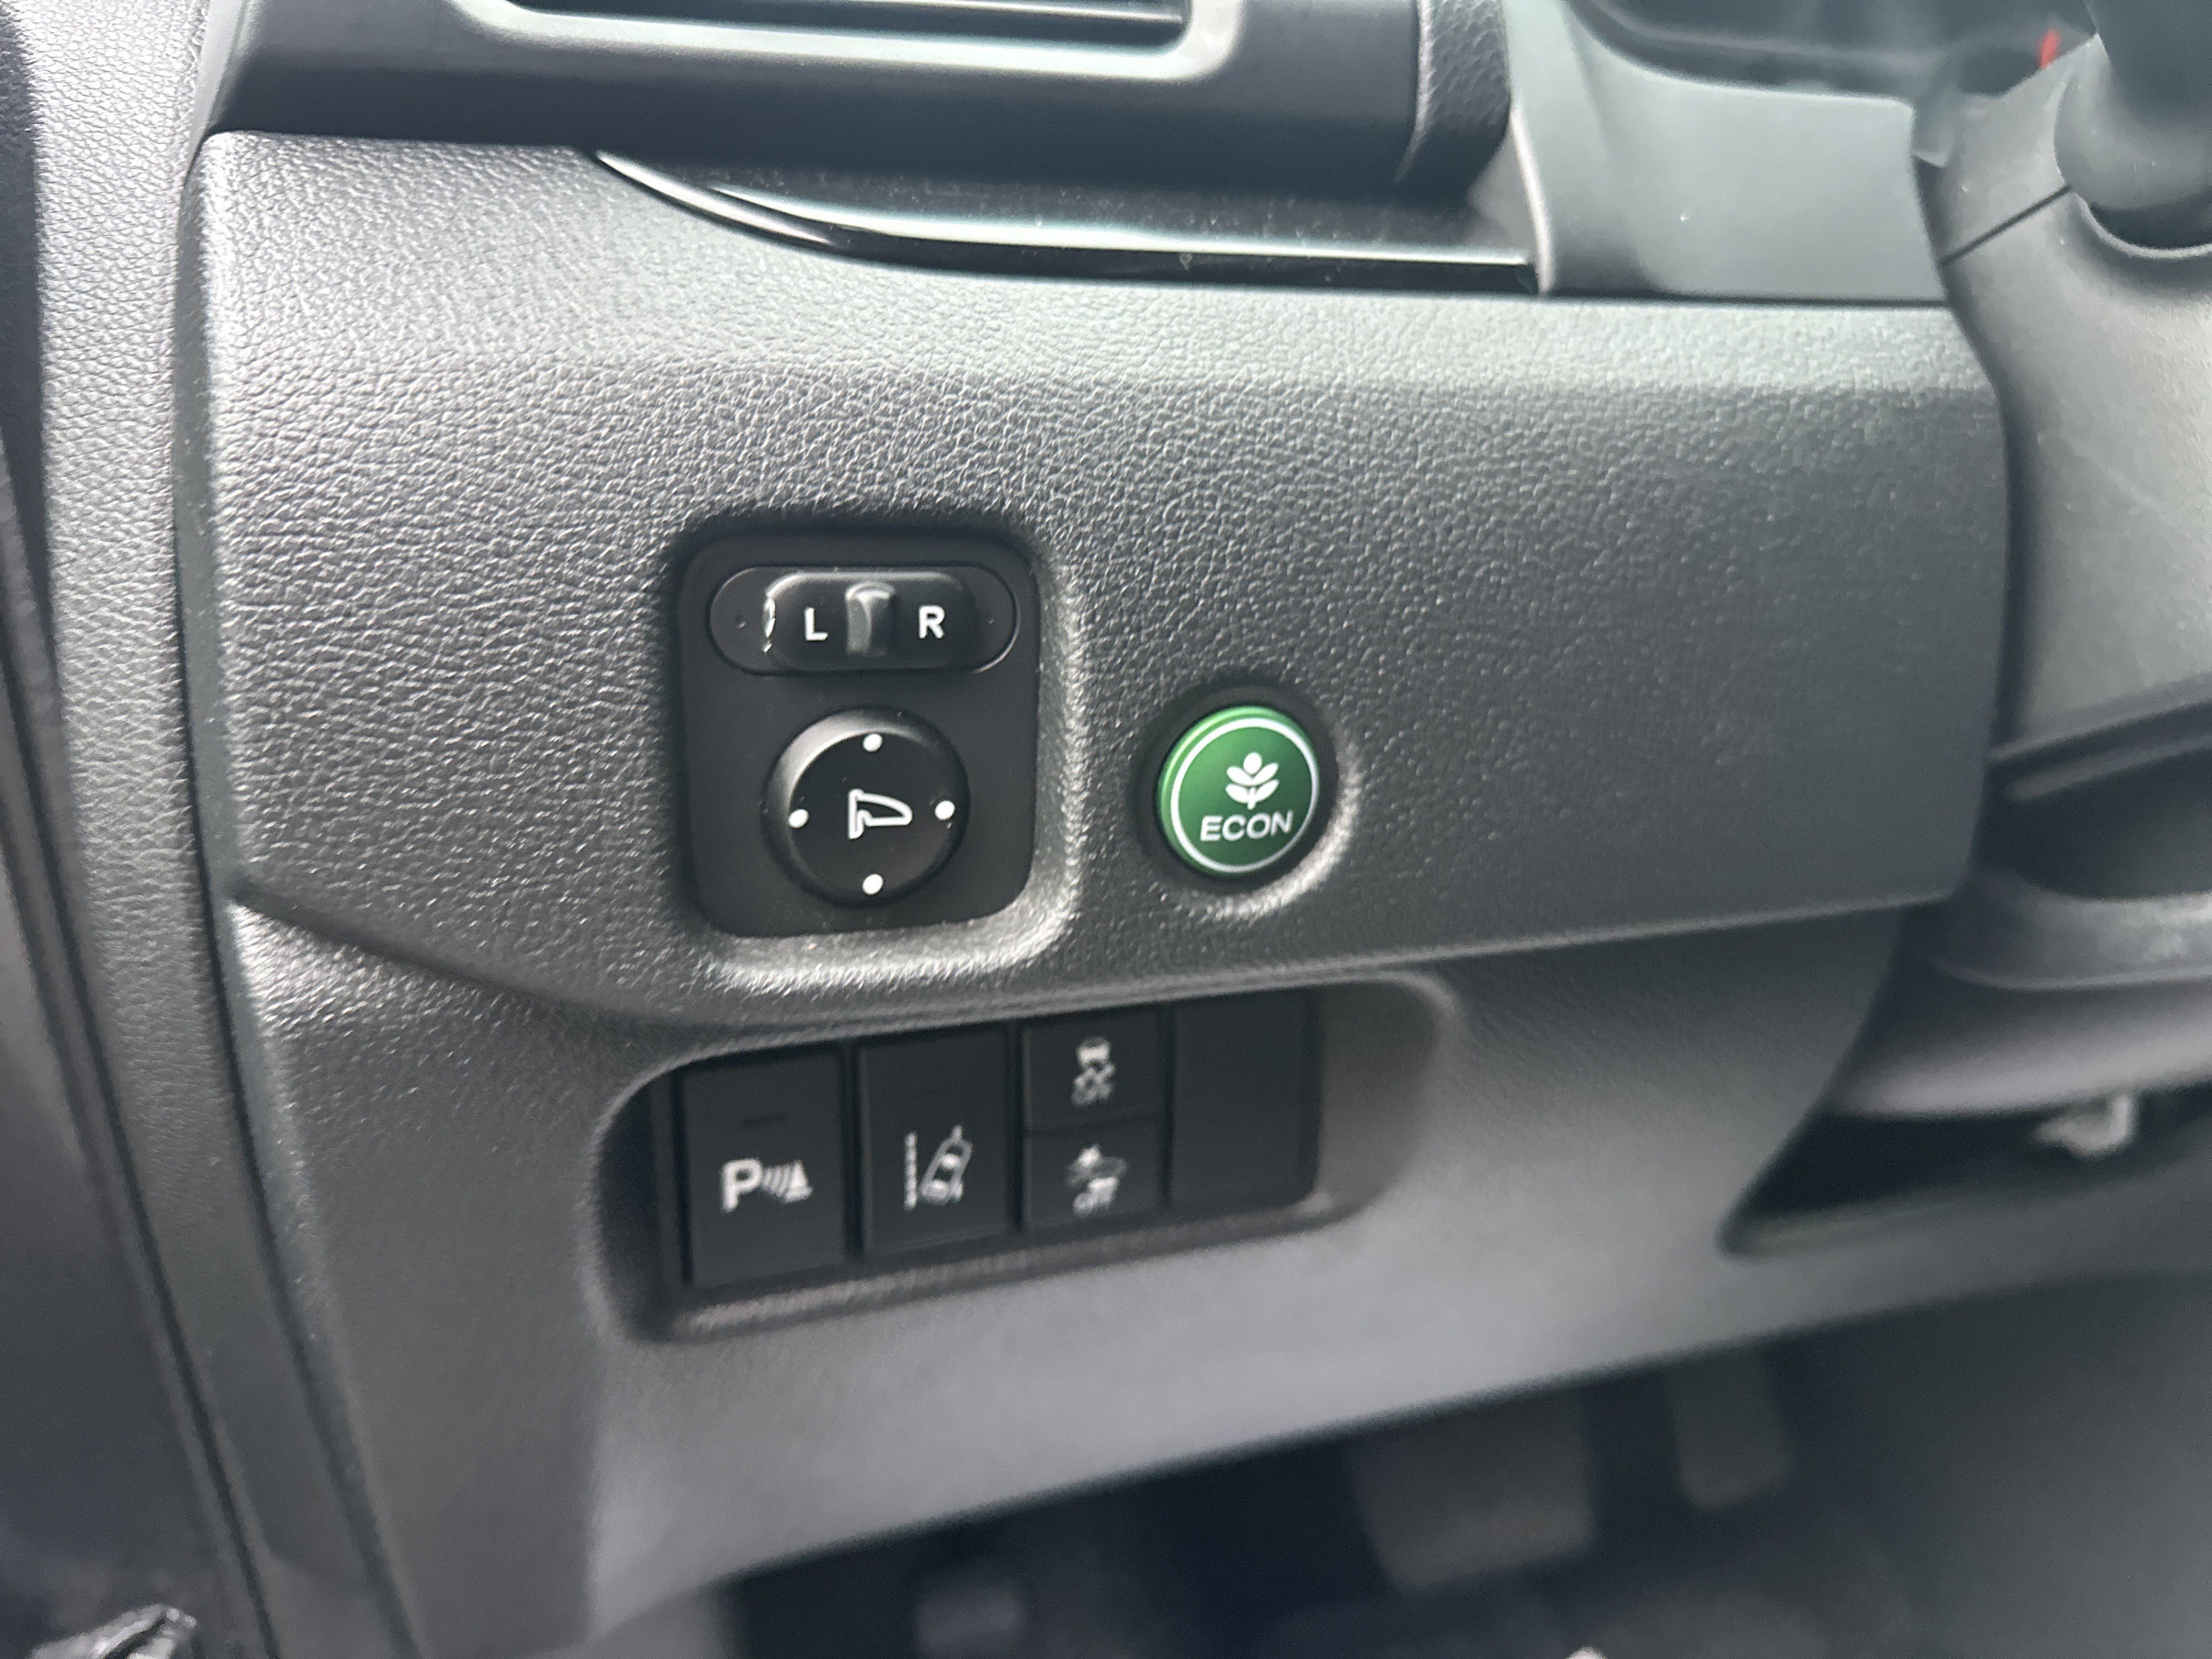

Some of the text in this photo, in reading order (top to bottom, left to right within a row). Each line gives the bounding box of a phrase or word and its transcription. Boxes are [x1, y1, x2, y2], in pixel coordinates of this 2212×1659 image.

[804, 605, 945, 641] L R
[1199, 810, 1294, 842] ECON
[721, 1158, 763, 1213] P
